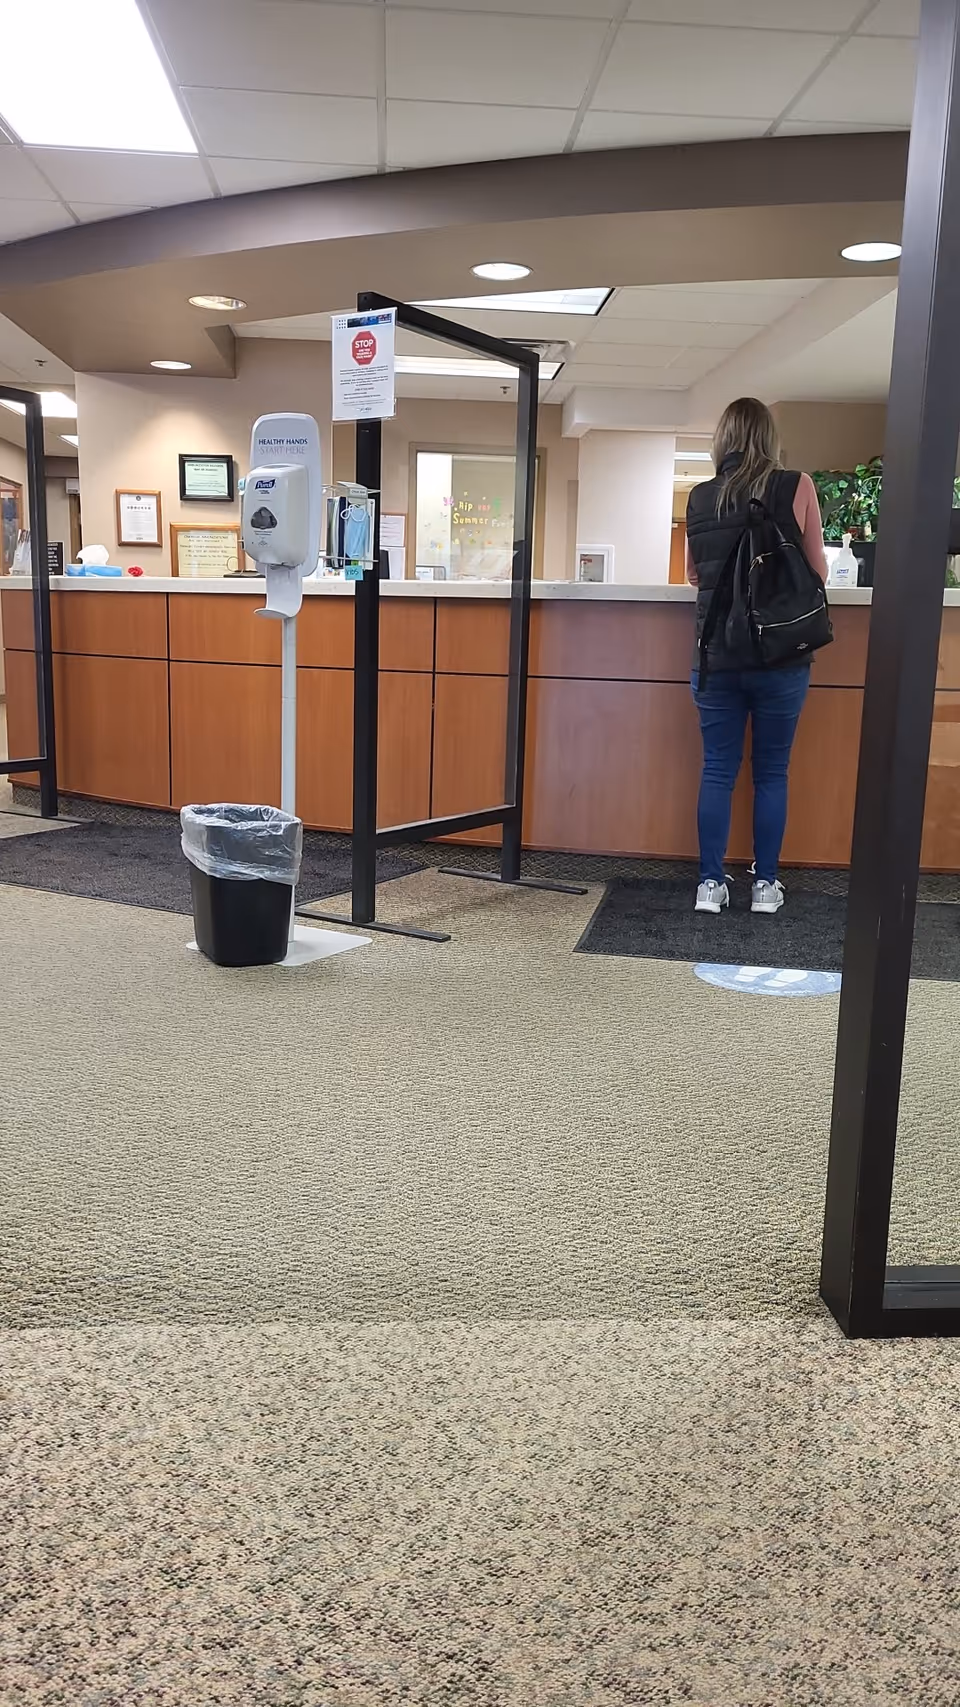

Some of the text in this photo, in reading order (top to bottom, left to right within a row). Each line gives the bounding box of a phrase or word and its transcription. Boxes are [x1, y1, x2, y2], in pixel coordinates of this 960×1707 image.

[355, 339, 374, 348] STOP
[259, 446, 284, 455] START
[453, 512, 489, 525] Summer
